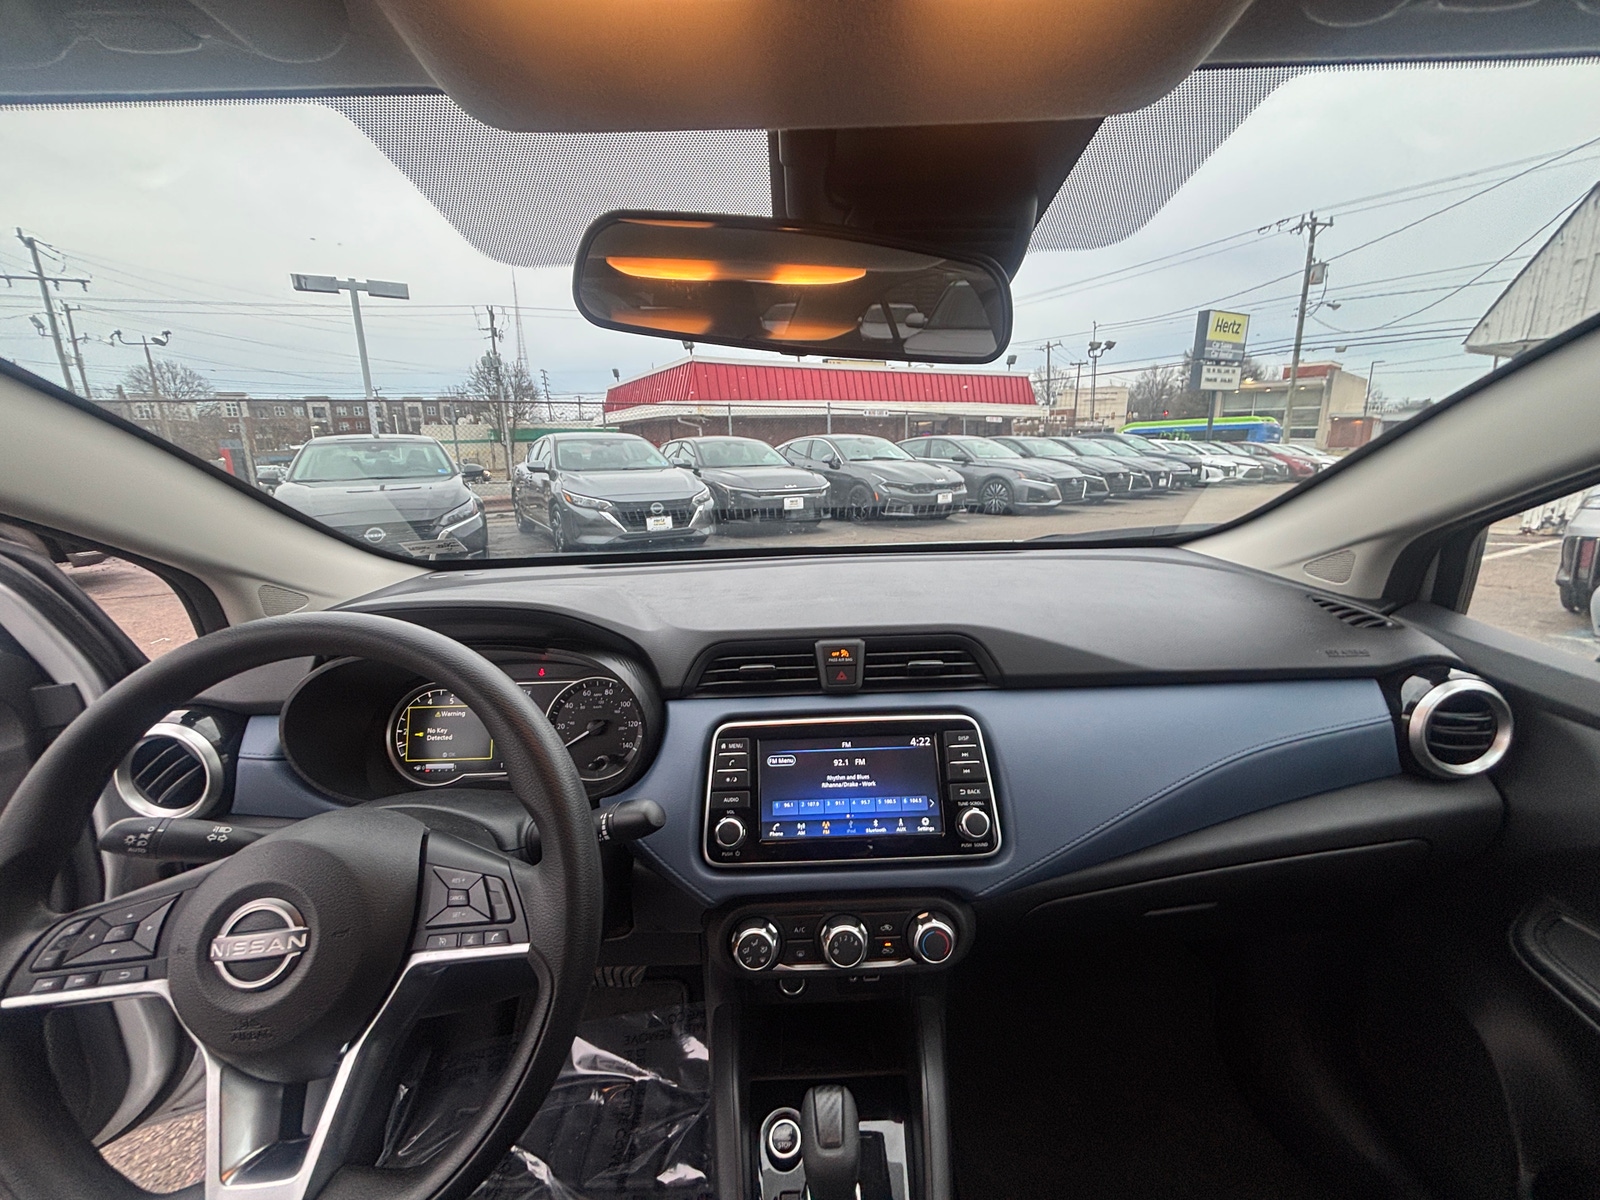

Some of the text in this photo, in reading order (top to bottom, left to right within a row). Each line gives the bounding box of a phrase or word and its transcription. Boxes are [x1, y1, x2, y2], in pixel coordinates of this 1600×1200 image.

[1214, 317, 1241, 334] Hertz
[441, 710, 466, 718] Warning
[436, 727, 448, 735] Key
[909, 737, 931, 746] 4:22
[855, 758, 866, 766] FM
[826, 774, 846, 782] Rhythm
[210, 933, 307, 957] NISSAN
[777, 1141, 792, 1150] STOP
